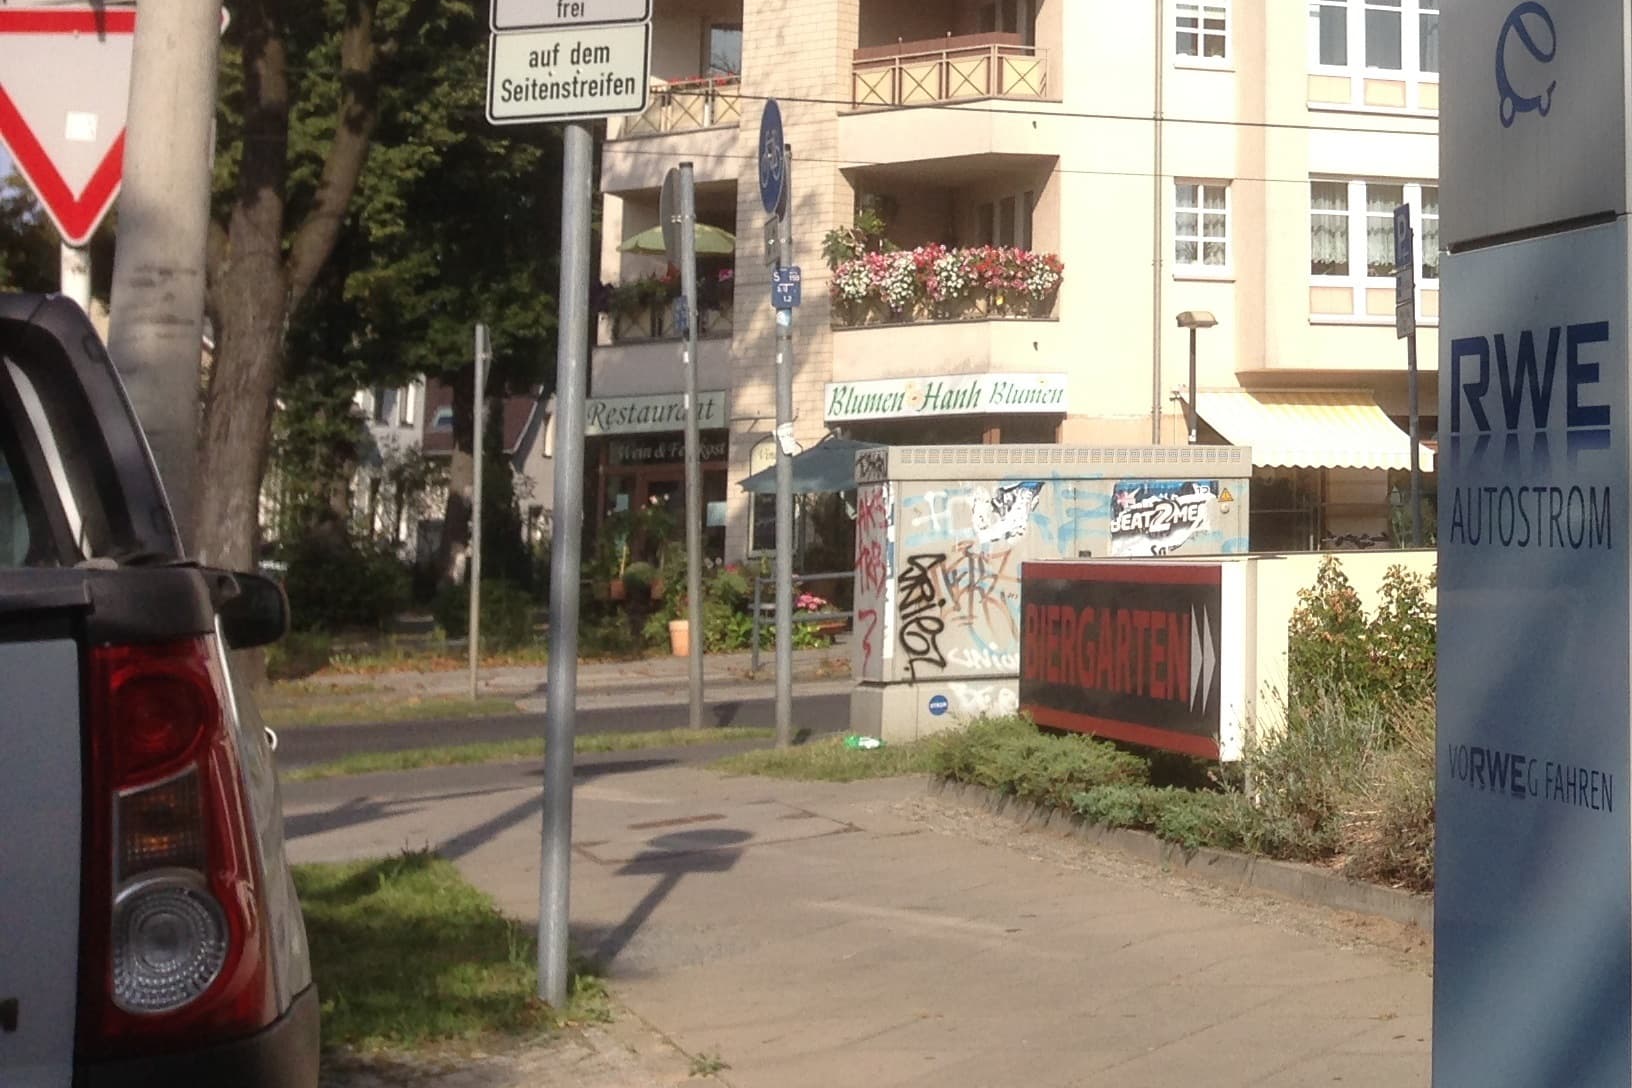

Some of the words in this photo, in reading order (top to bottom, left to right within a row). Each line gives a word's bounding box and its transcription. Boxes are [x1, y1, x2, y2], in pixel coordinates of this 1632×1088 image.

[529, 42, 561, 68] auf
[570, 41, 611, 65] dem
[500, 72, 636, 103] Seitenstreifen
[827, 384, 906, 417] Blumen
[916, 379, 983, 413] Hanh
[988, 381, 1064, 405] Blumen
[1450, 320, 1611, 433] RWE
[1449, 485, 1612, 550] AUTOSTROM
[1025, 602, 1191, 703] BIERGARTEN
[1448, 743, 1539, 798] VORWEG
[1545, 761, 1613, 813] FAHREN
